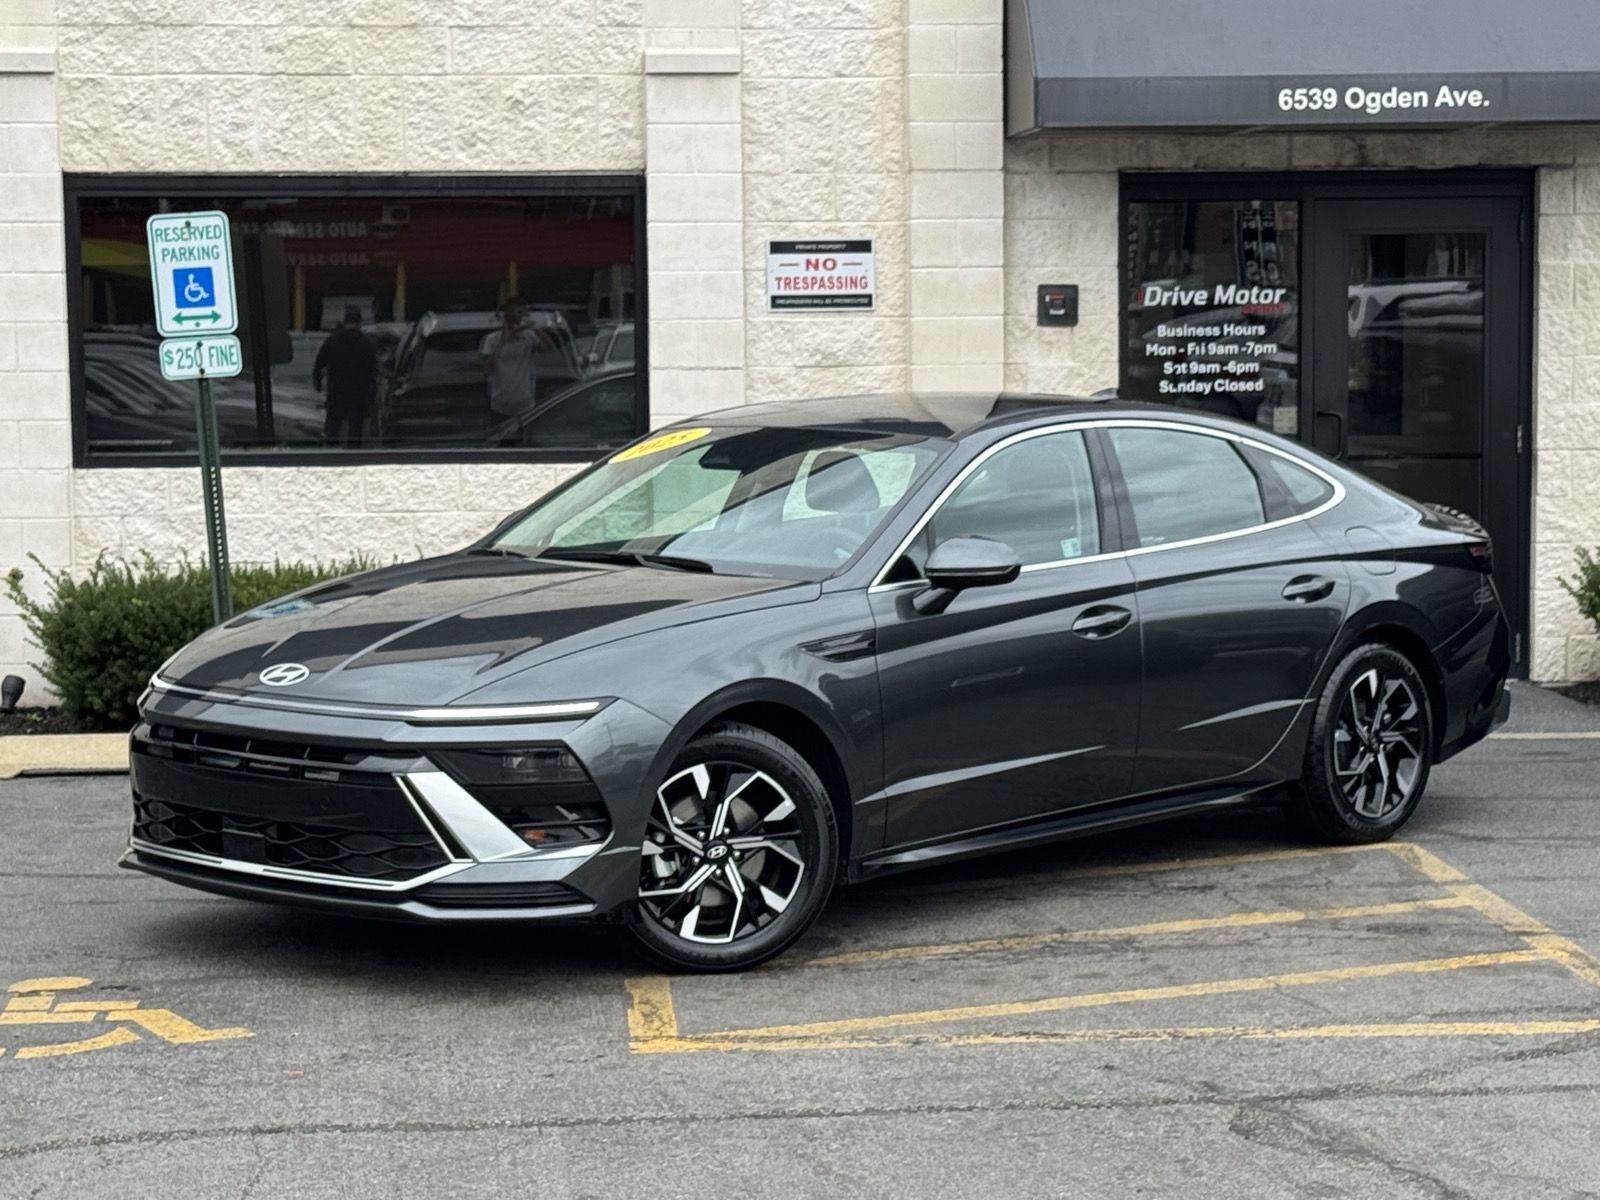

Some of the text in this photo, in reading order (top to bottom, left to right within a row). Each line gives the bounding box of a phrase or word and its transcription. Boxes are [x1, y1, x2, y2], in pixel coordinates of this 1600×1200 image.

[1278, 85, 1490, 115] 6539 Ogden Ave.
[155, 224, 222, 243] RESERVED
[162, 245, 220, 263] PARKING
[805, 257, 837, 272] NO
[775, 275, 868, 291] TRESPASSING
[1213, 284, 1287, 305] Motor
[1157, 323, 1266, 338] Business Hours
[208, 344, 238, 367] FINE
[1145, 343, 1176, 357] Mon
[1208, 342, 1239, 355] 9am
[1189, 361, 1220, 374] 9am
[1213, 378, 1265, 392] Closed
